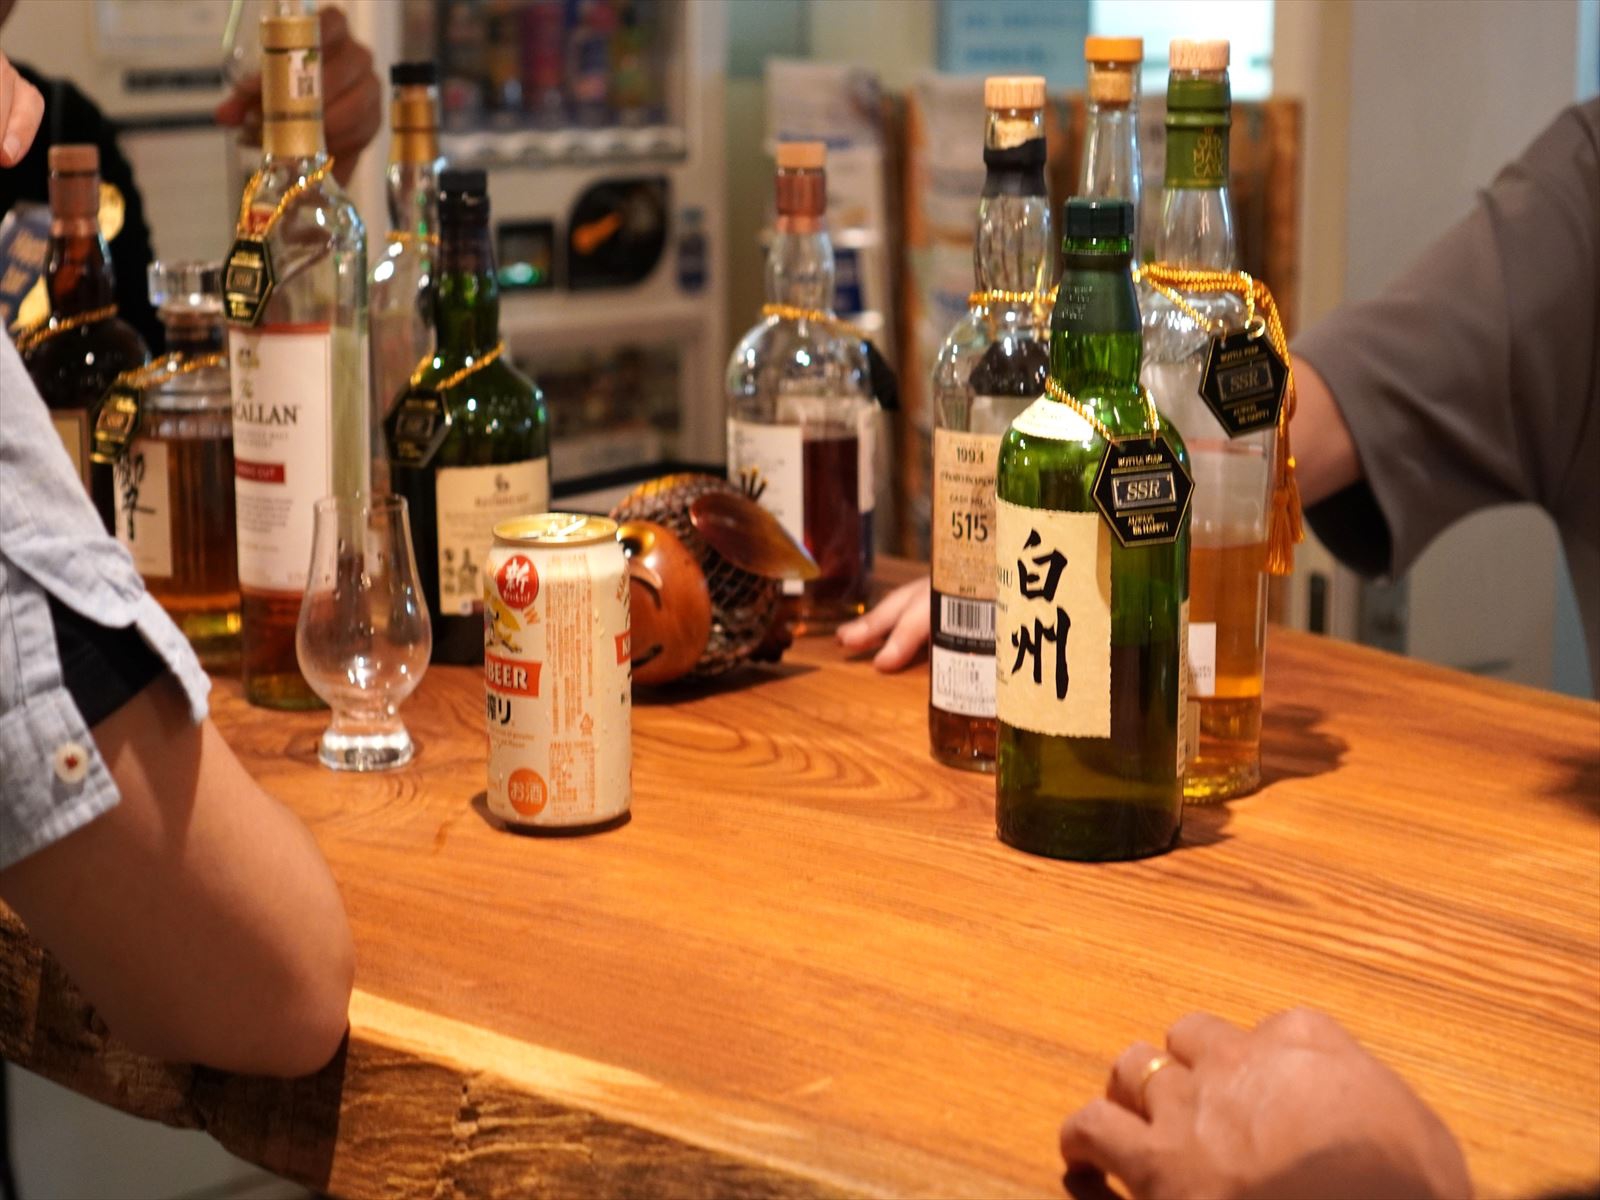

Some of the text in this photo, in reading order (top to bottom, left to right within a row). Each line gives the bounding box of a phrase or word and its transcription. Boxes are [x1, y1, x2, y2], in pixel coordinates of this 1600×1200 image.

[1194, 163, 1224, 178] CASK
[1127, 480, 1160, 500] SSR
[951, 511, 989, 542] 515
[504, 557, 531, 595] 新
[1011, 528, 1071, 701] 白州
[487, 660, 528, 691] BEER
[510, 781, 543, 805] お酒
